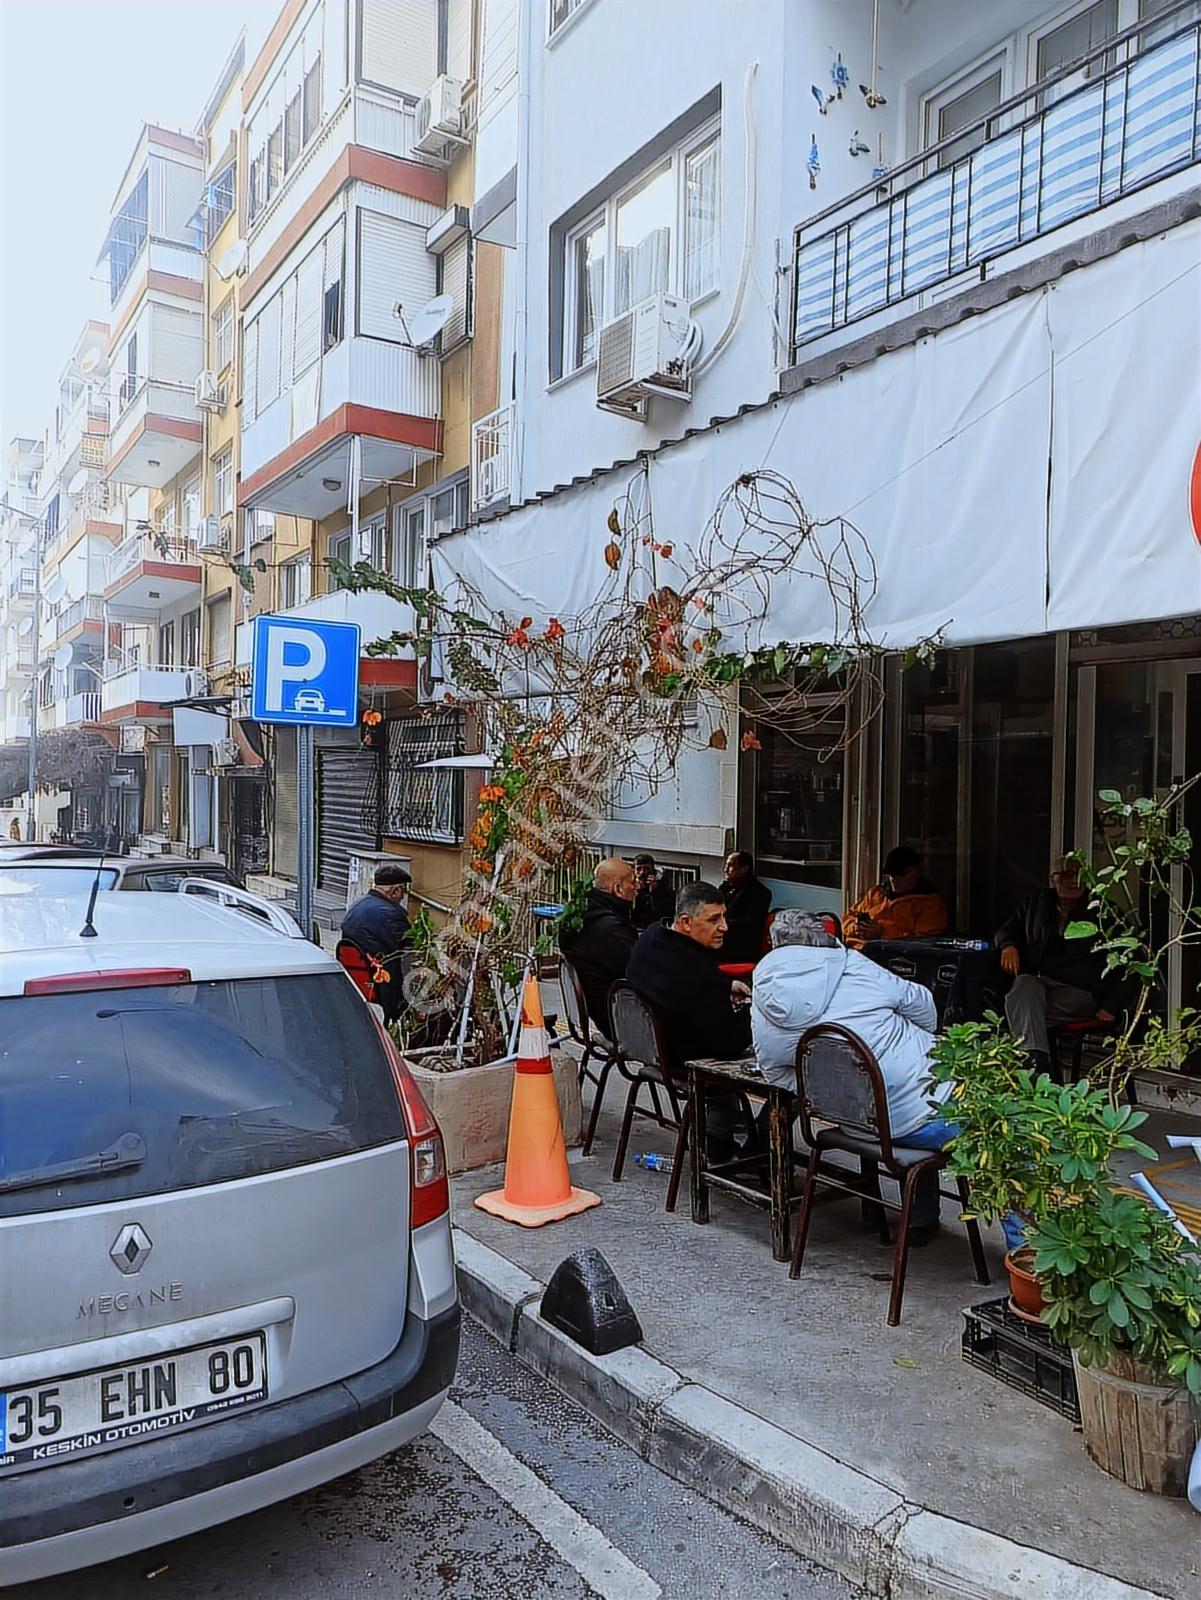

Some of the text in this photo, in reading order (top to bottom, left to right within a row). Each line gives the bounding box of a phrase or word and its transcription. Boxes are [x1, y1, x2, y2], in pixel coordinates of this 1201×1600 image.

[265, 625, 327, 711] P
[75, 1281, 183, 1320] MEGANE
[8, 1345, 254, 1444] 35 EHN 80
[33, 1433, 102, 1460] KESKİN
[105, 1409, 196, 1441] OTOMOTİV
